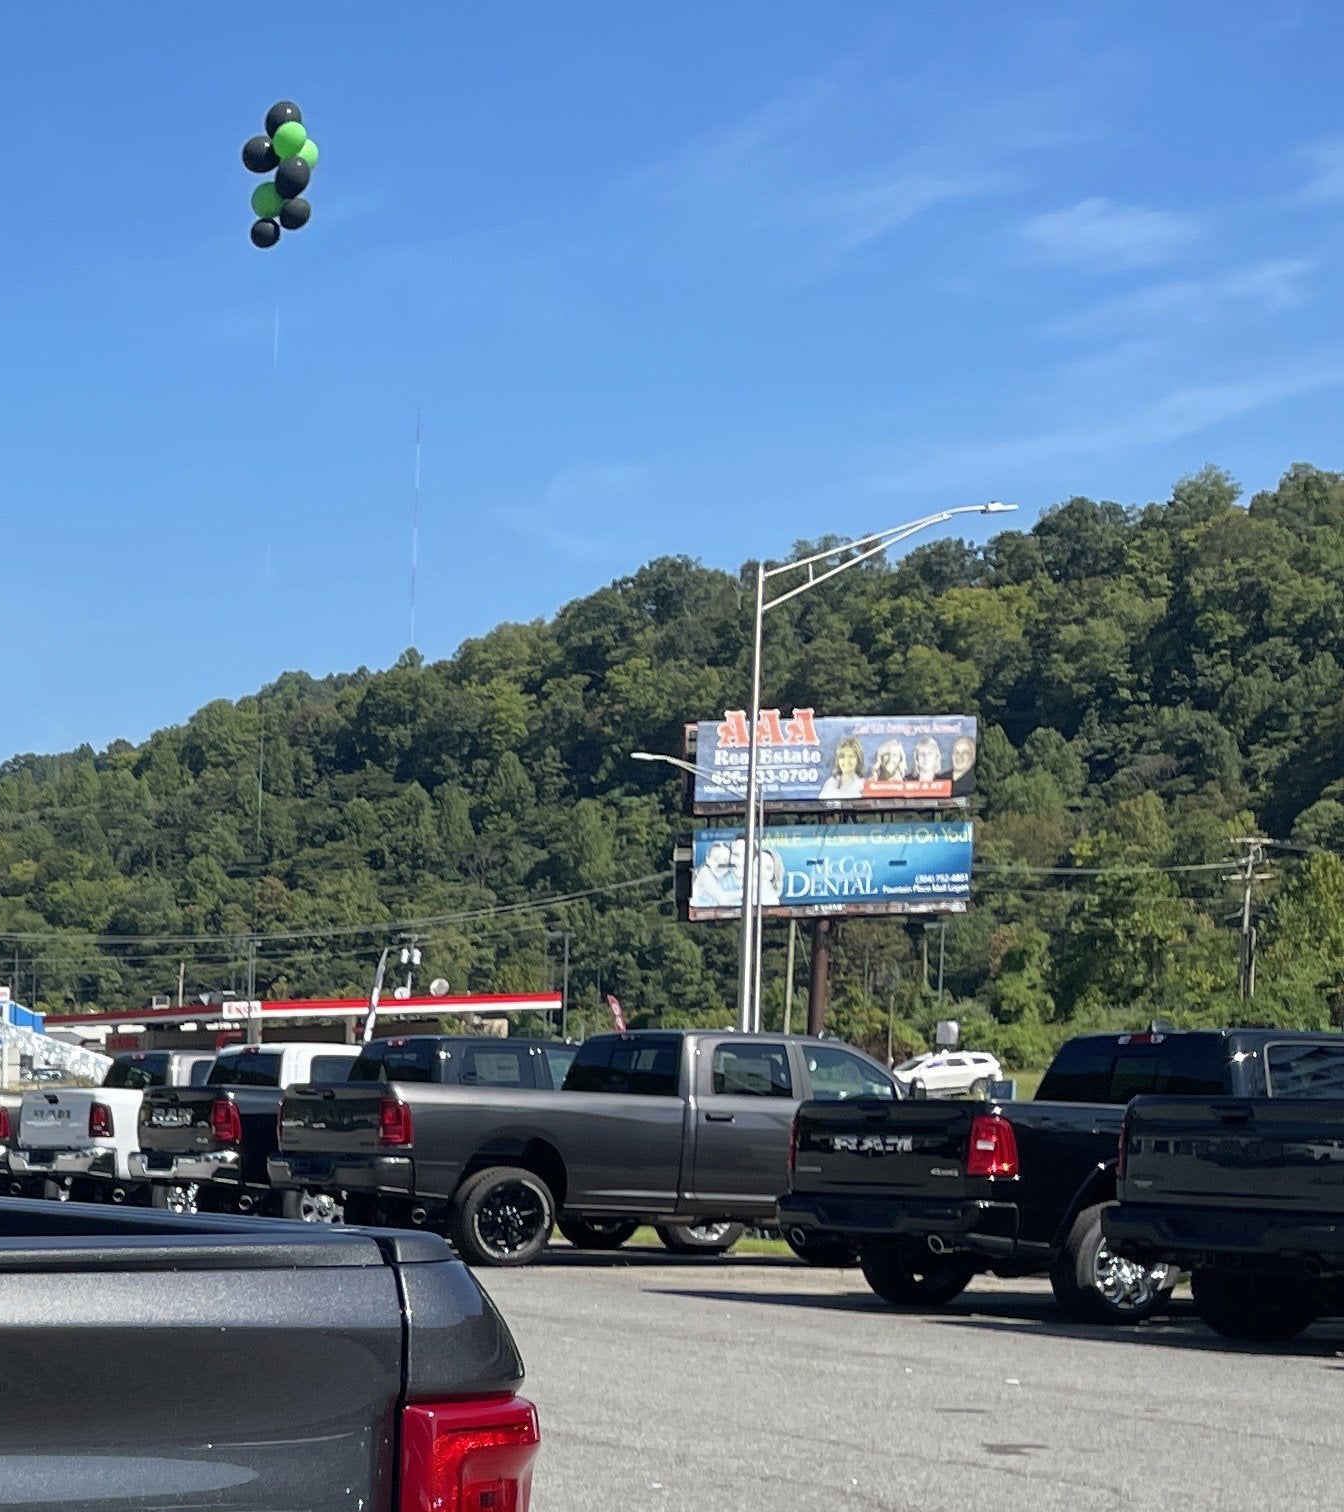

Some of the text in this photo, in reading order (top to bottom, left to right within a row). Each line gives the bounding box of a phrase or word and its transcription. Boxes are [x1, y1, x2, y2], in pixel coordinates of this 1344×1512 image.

[717, 708, 821, 748] AAA
[758, 748, 822, 764] Estate
[785, 870, 879, 898] DENTAL
